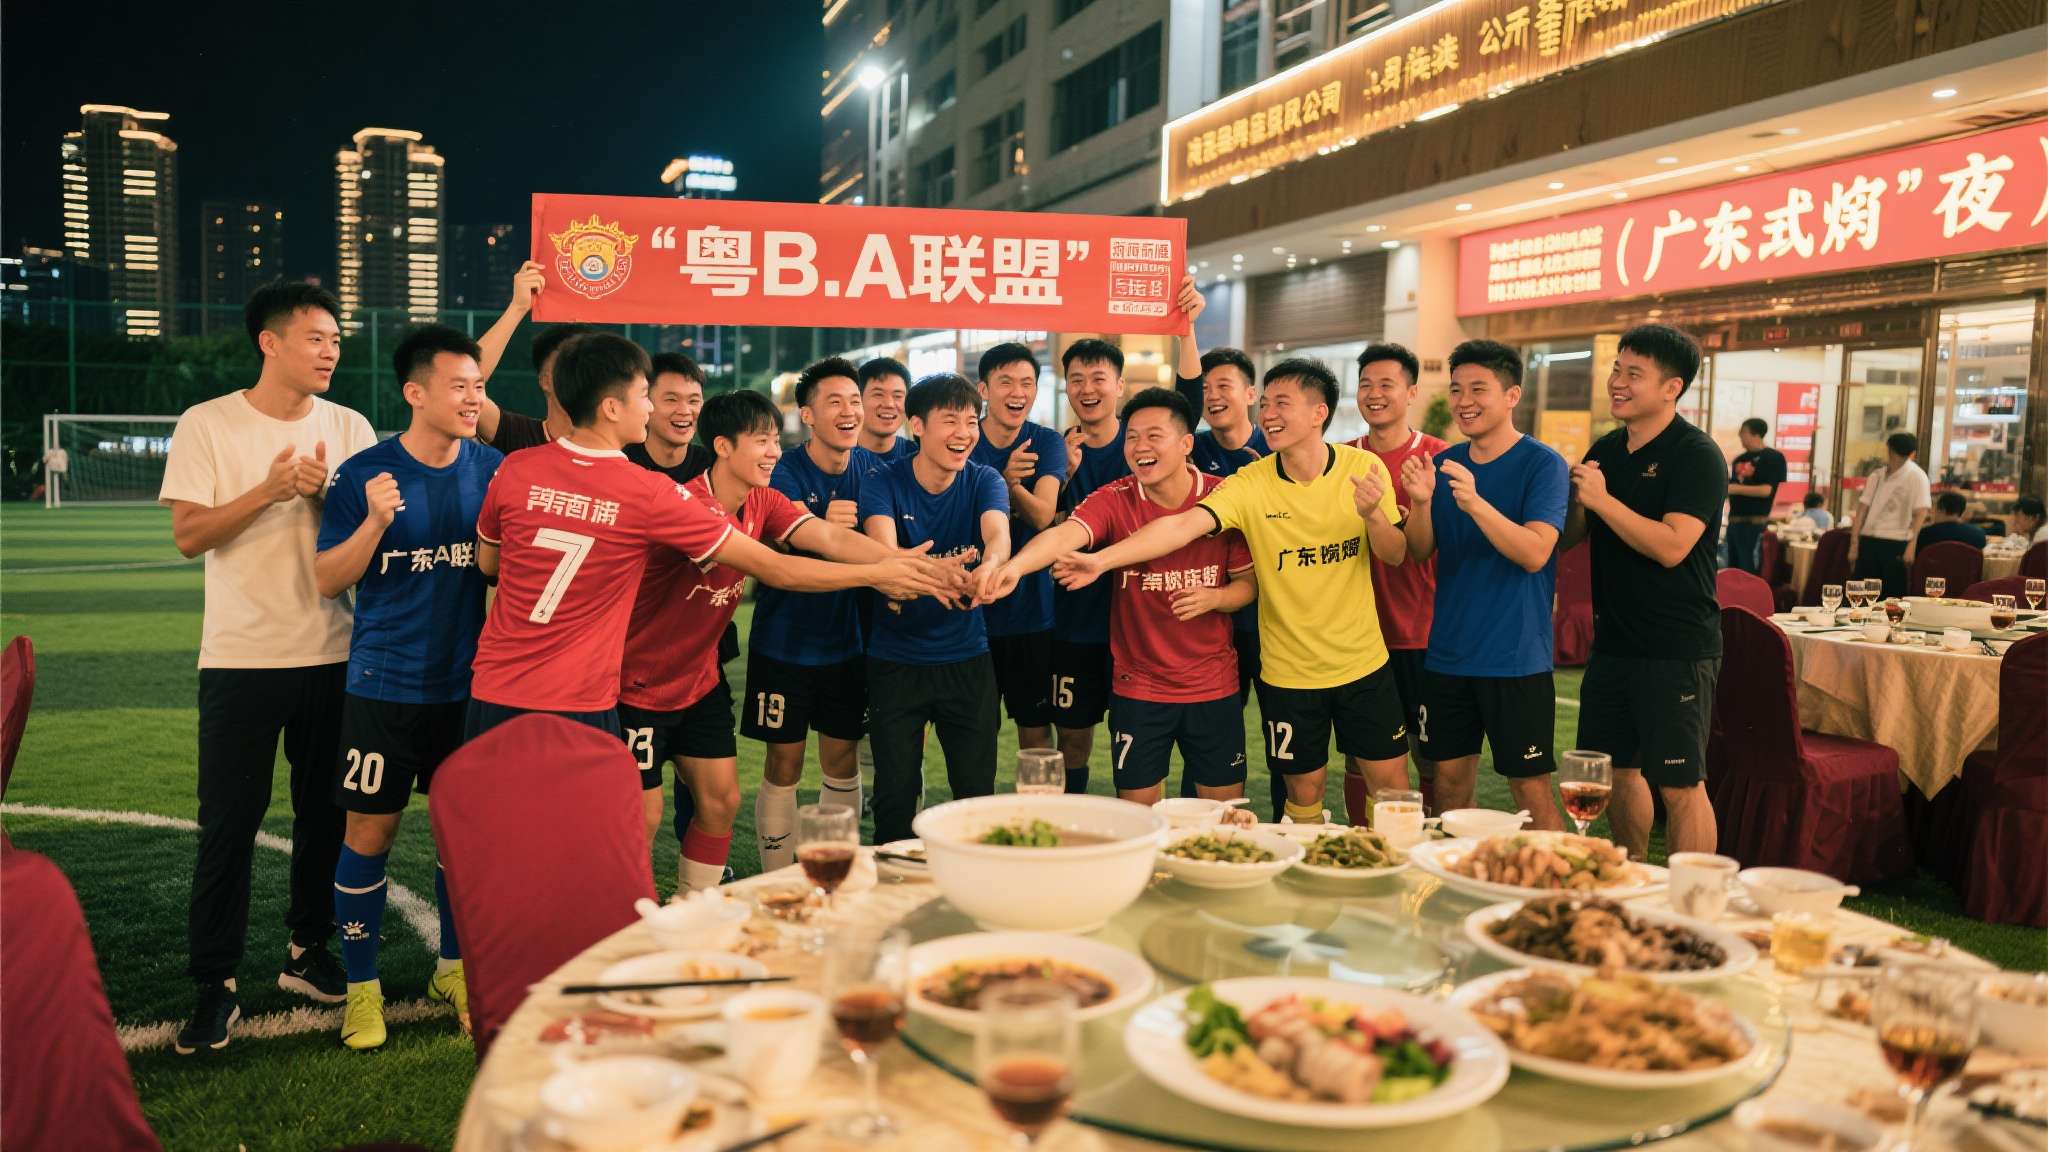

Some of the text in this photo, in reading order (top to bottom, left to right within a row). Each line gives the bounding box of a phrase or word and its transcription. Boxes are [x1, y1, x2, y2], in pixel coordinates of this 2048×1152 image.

[651, 225, 1090, 306] “粤B.A联盟”
[529, 527, 596, 625] 7
[1052, 674, 1074, 708] 15
[1267, 720, 1294, 760] 12
[343, 747, 385, 795] 20
